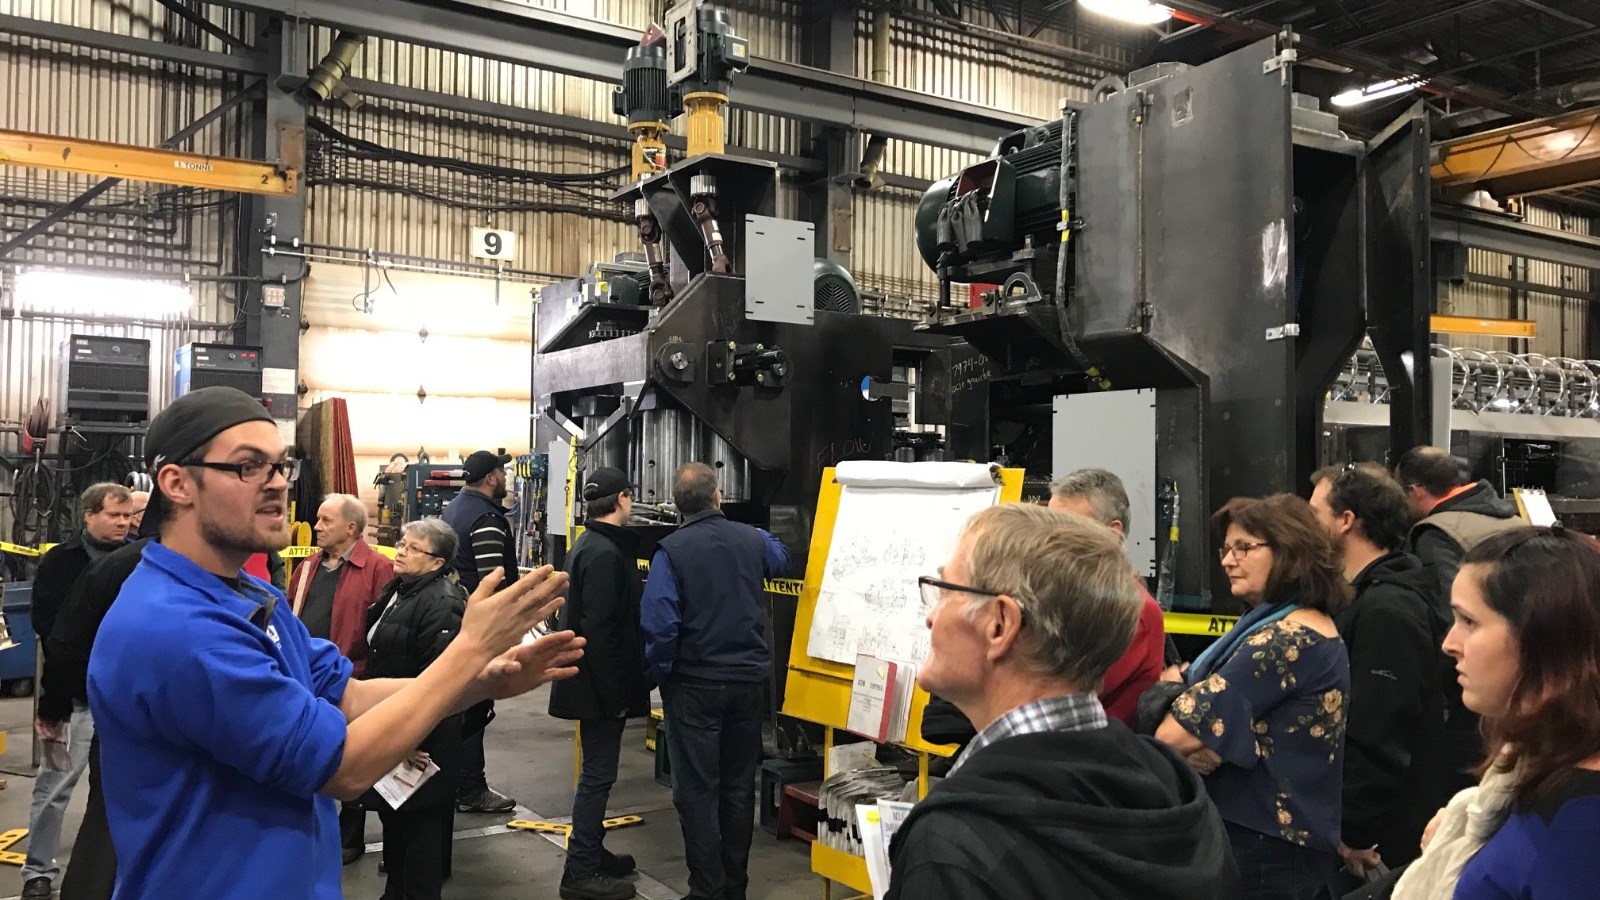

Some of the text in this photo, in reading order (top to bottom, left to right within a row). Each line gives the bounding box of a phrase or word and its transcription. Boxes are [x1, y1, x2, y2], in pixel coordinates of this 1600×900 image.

[185, 162, 213, 171] TONNE
[261, 174, 269, 185] 2
[484, 232, 502, 256] 9
